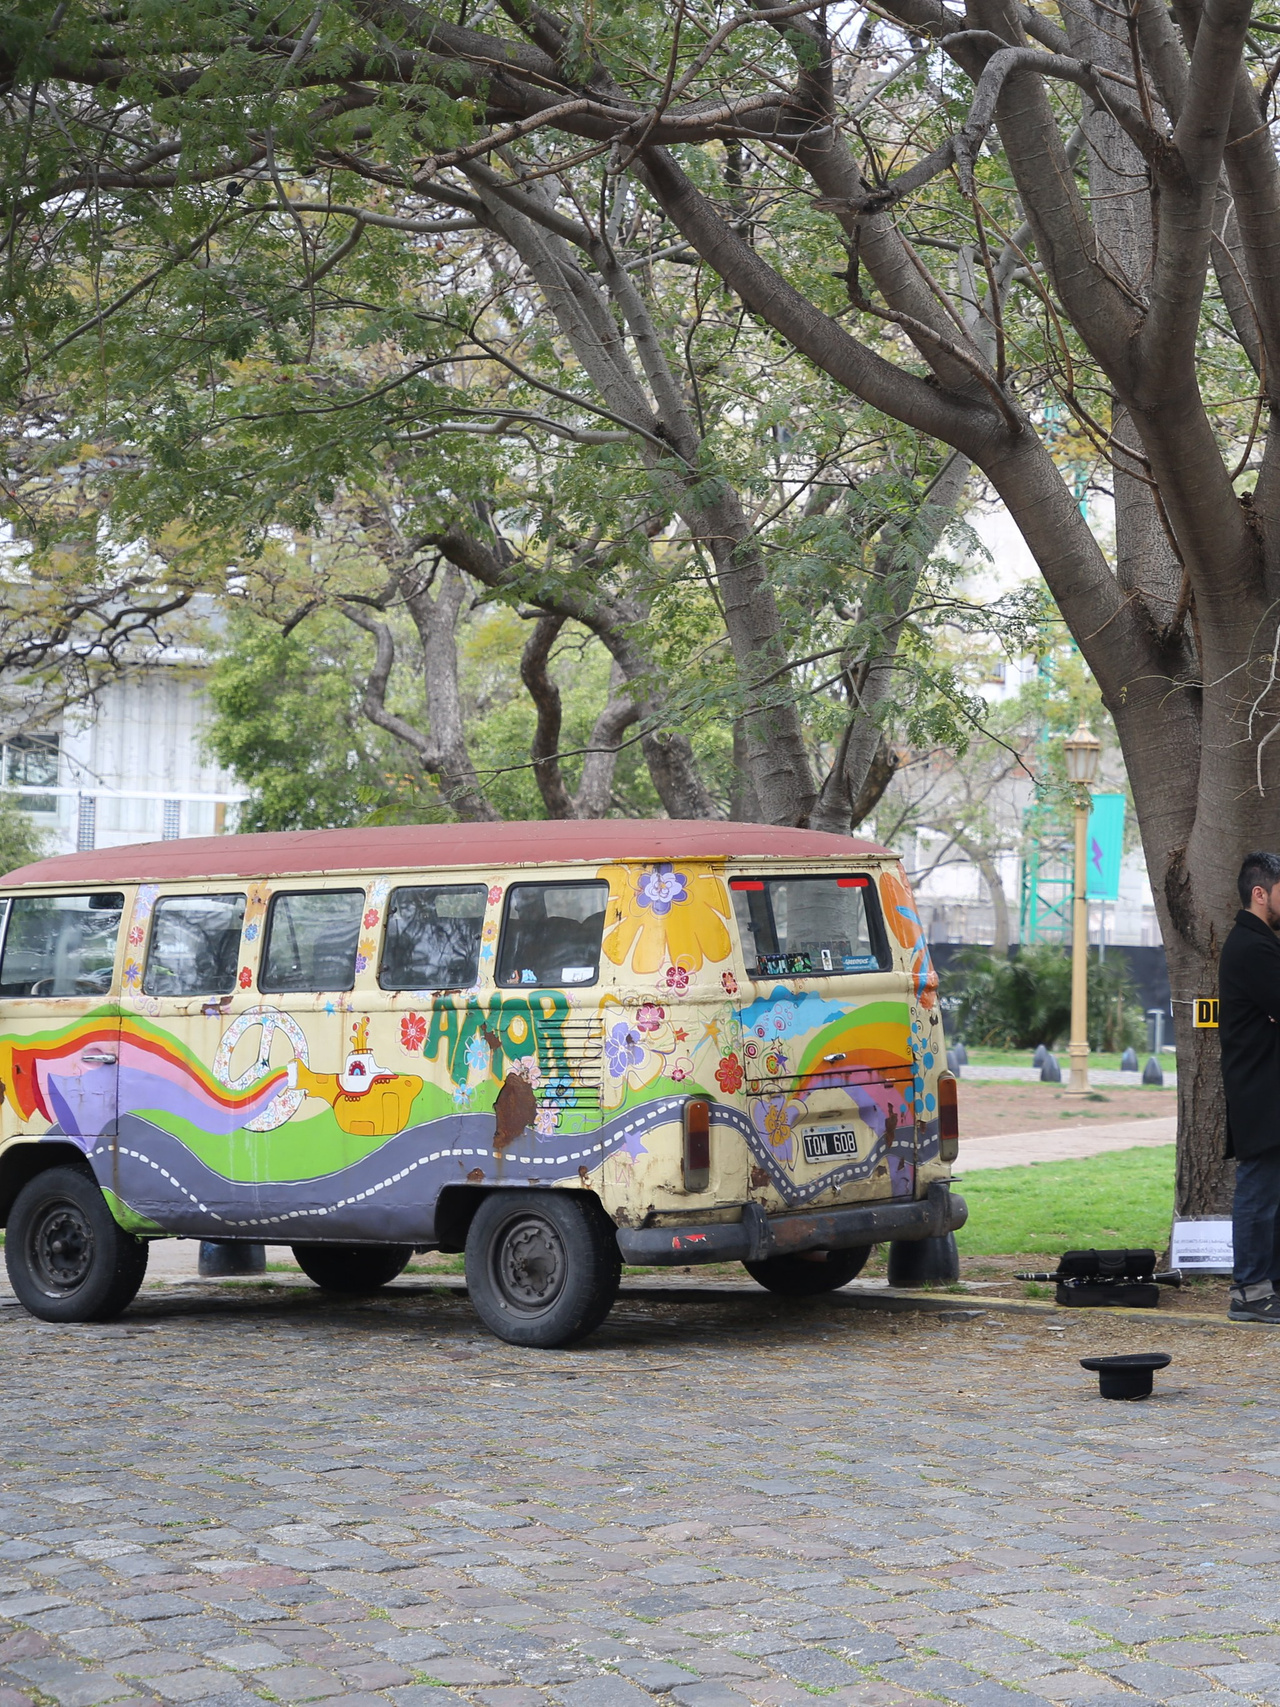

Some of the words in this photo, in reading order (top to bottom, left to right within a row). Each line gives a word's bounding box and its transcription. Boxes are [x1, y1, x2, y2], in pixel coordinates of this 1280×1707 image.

[1198, 1000, 1219, 1023] DI
[423, 989, 571, 1083] AMOR
[833, 1132, 856, 1153] 608
